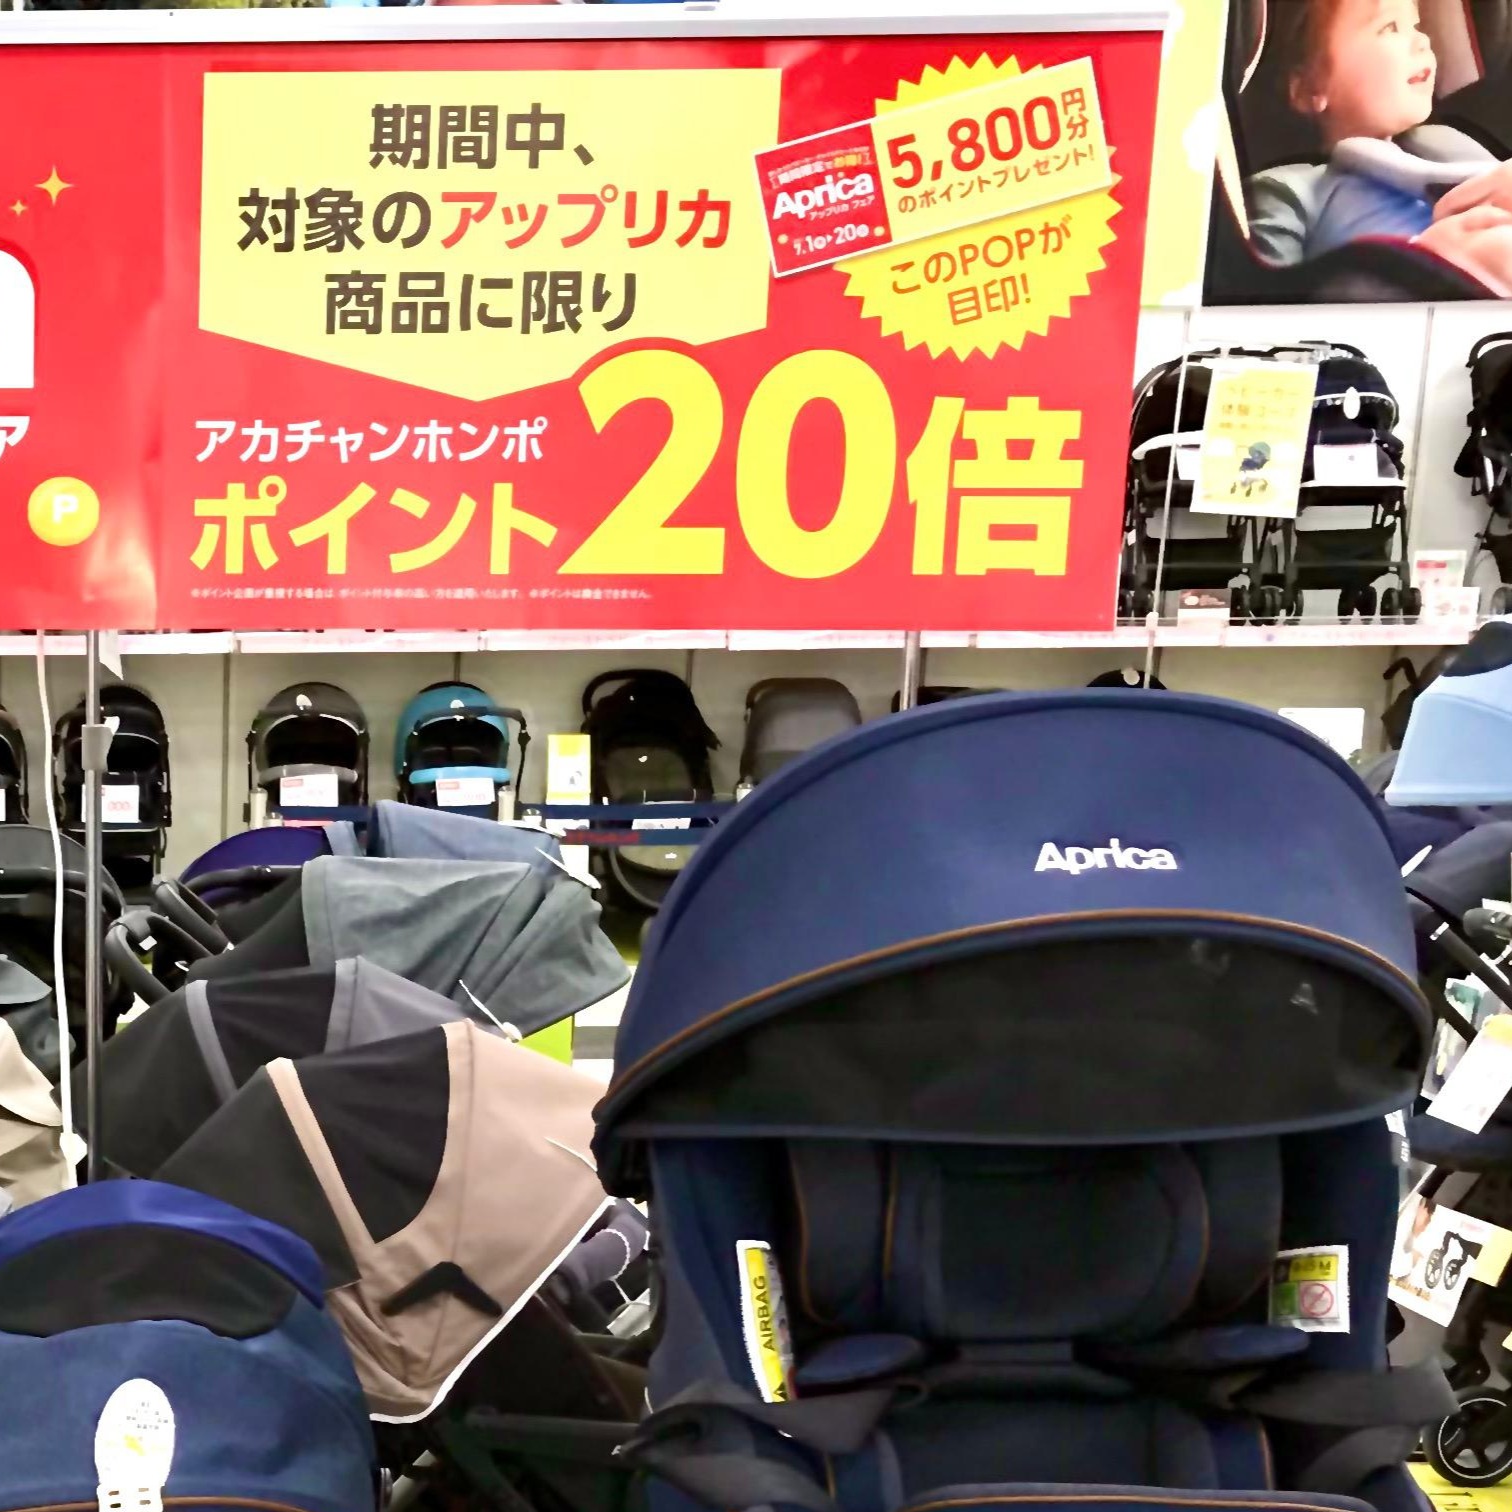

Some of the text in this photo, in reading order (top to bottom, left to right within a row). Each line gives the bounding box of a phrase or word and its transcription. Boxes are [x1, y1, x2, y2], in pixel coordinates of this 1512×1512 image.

[367, 103, 596, 170] 期間中、
[237, 189, 731, 254] 対象のアップリカ
[772, 171, 875, 222] Aprica
[324, 269, 639, 338] 商品に限り
[194, 417, 548, 465] アカチャンホンポ
[1034, 837, 1178, 875] Aprica
[753, 1275, 776, 1352] AIRBAG
